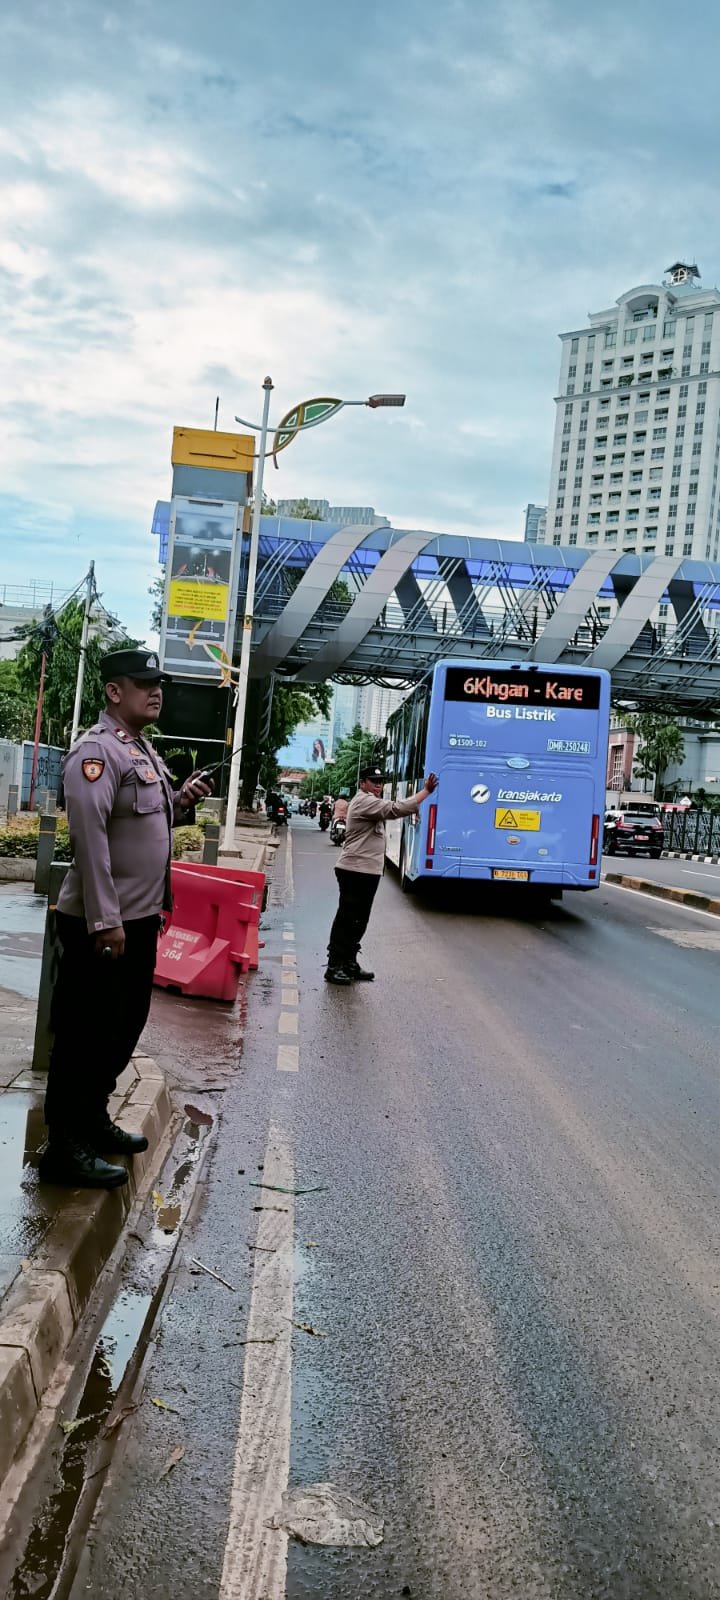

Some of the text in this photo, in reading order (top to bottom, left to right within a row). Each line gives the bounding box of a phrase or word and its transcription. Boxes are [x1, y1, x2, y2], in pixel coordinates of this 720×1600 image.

[545, 681, 583, 701] Kare
[486, 705, 556, 721] Bus Listrik
[457, 738, 487, 748] 1500-102
[496, 788, 562, 803] transjakarta
[161, 948, 183, 961] 364
